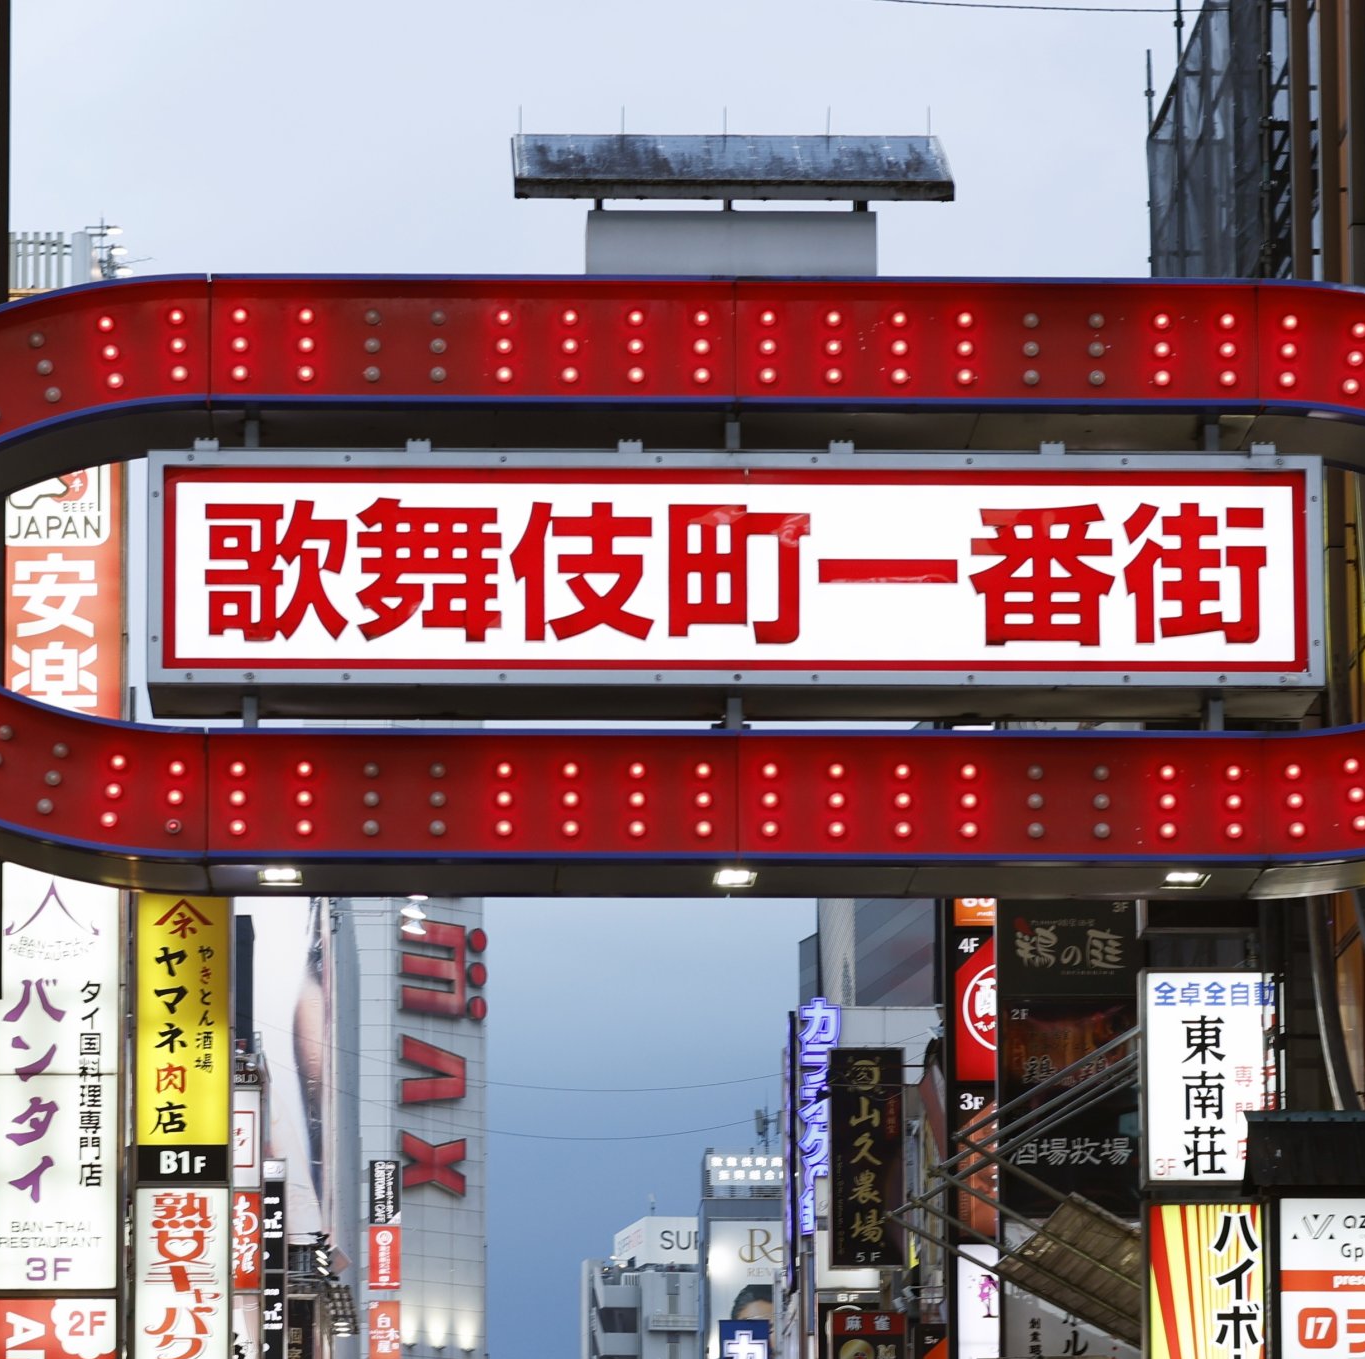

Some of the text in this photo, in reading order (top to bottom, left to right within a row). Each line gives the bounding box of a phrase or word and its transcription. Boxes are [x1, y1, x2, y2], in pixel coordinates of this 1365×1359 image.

[61, 502, 96, 513] BEEF
[6, 514, 102, 540] JAPAN
[202, 498, 1269, 646] 歌舞伎町一番街
[957, 937, 980, 953] 4F
[1153, 981, 1276, 1007] 全卓全自動
[195, 945, 215, 1074] やきとん酒場
[150, 946, 190, 1136] ヤマネ肉店
[2, 977, 67, 1204] バンタイ
[78, 980, 103, 1188] タイ国料理専門店
[1180, 1014, 1227, 1177] 東南荘
[959, 1093, 984, 1111] 3F
[159, 1150, 207, 1175] B1F
[1008, 1137, 1133, 1166] 酒場牧場
[849, 1097, 884, 1244] 山久農場
[1154, 1158, 1177, 1177] 3F
[10, 1220, 92, 1234] BAN-THAI
[25, 1257, 73, 1282] 3F
[854, 1251, 881, 1264] 5F
[68, 1311, 107, 1337] 2F
[844, 1315, 892, 1332] 麻雀
